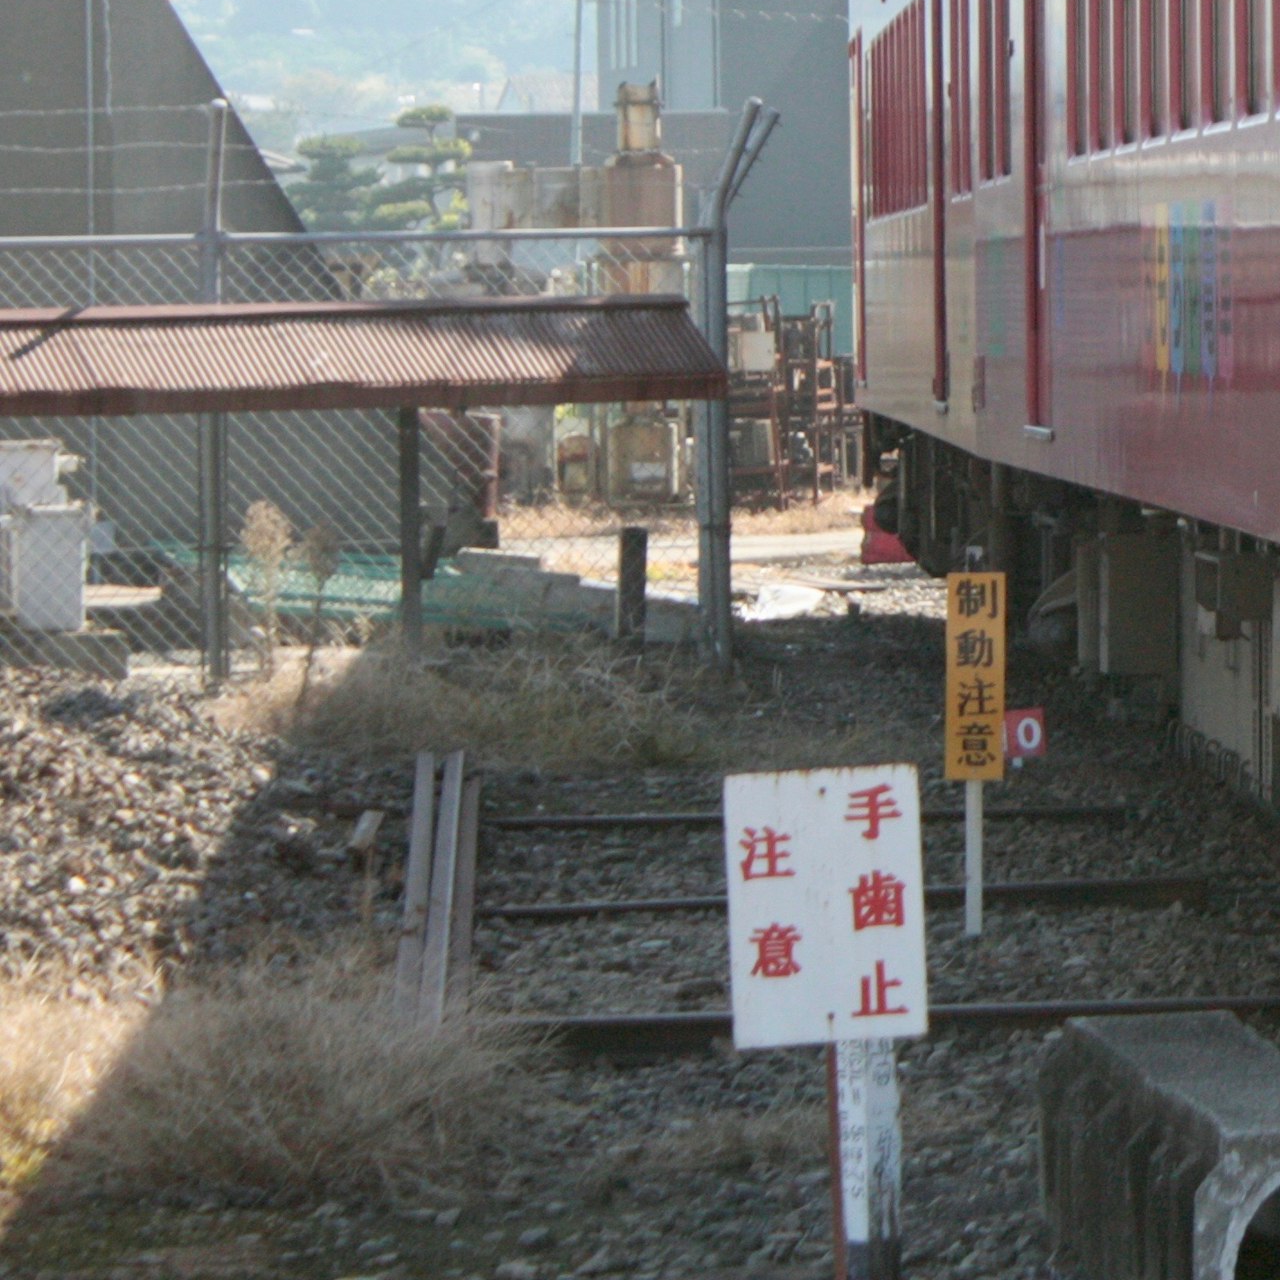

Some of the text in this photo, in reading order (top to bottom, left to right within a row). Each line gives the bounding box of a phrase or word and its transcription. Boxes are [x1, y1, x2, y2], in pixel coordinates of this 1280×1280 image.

[955, 578, 997, 767] 制動注意
[738, 826, 803, 979] 注意
[845, 783, 908, 1019] 手歯止
